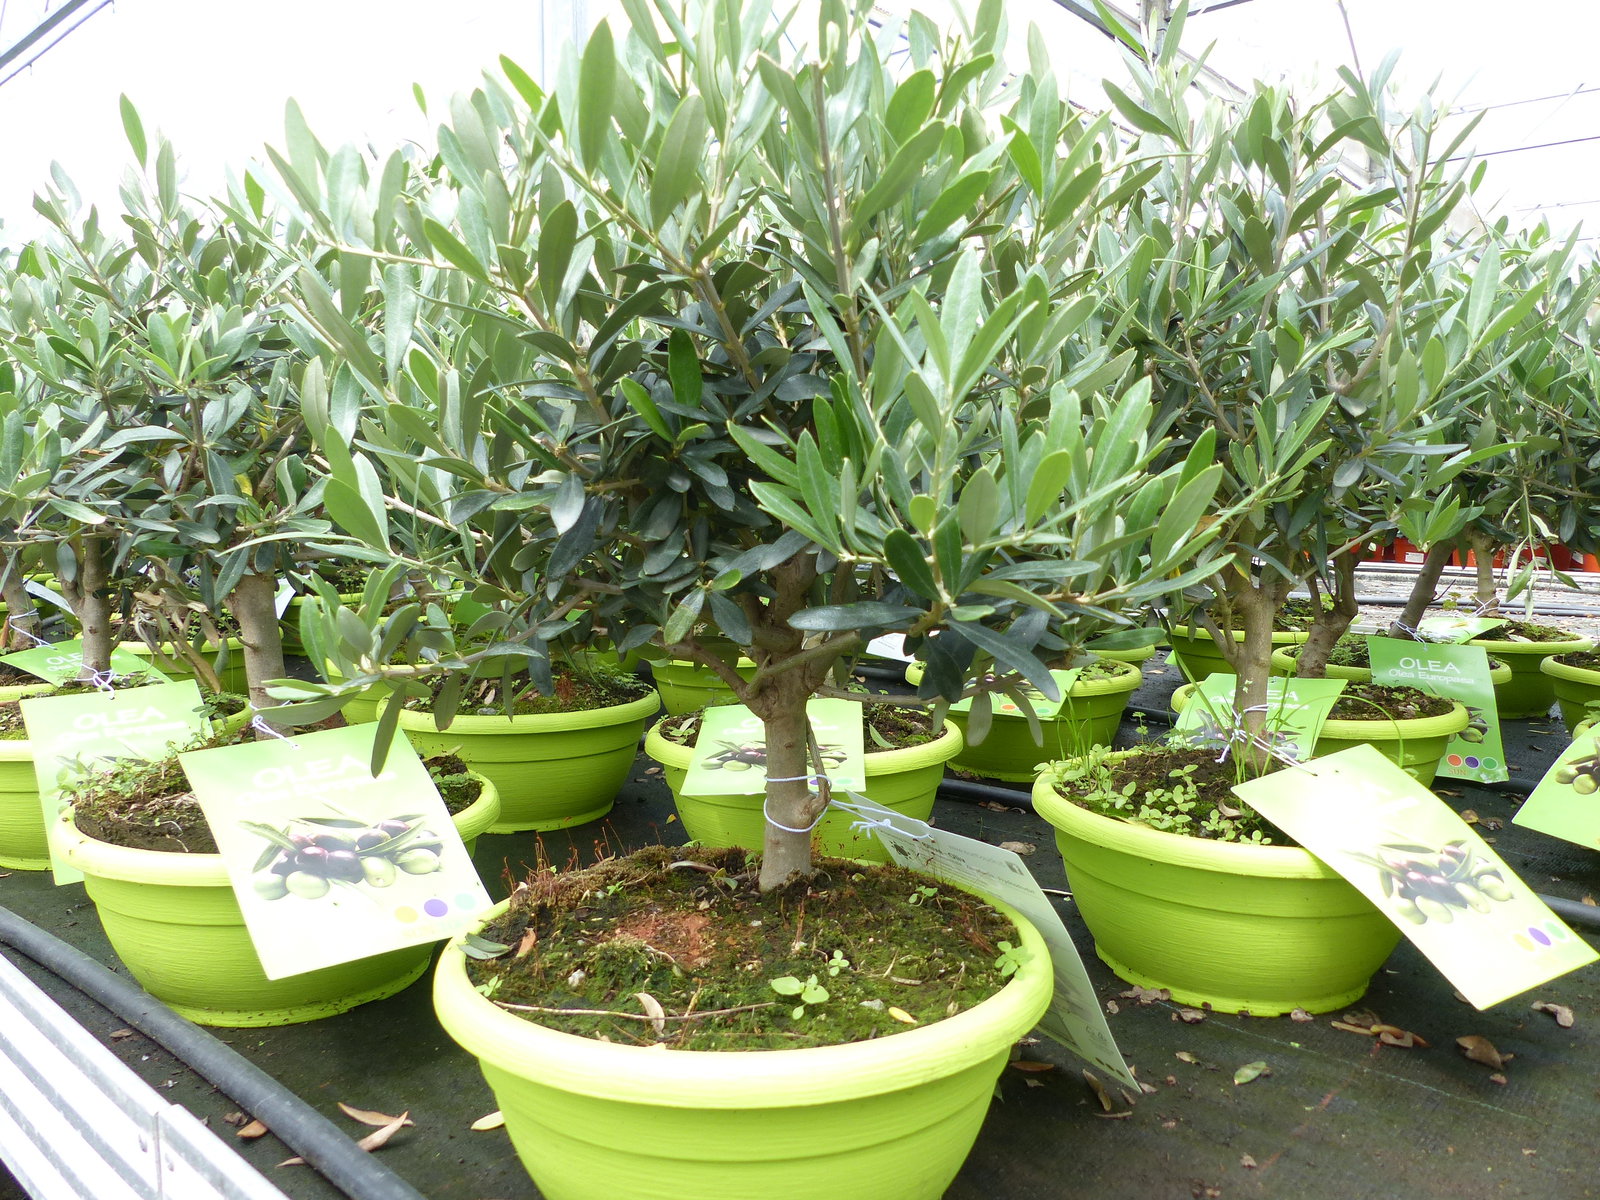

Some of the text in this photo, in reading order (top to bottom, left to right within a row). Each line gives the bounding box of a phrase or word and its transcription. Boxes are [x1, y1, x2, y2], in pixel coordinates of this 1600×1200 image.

[46, 652, 83, 665] OLE
[1399, 657, 1461, 674] OLEA
[1388, 668, 1474, 685] Olea Europaea
[73, 706, 167, 729] OLEA
[252, 754, 372, 788] OLEA
[1448, 768, 1467, 776] SUN
